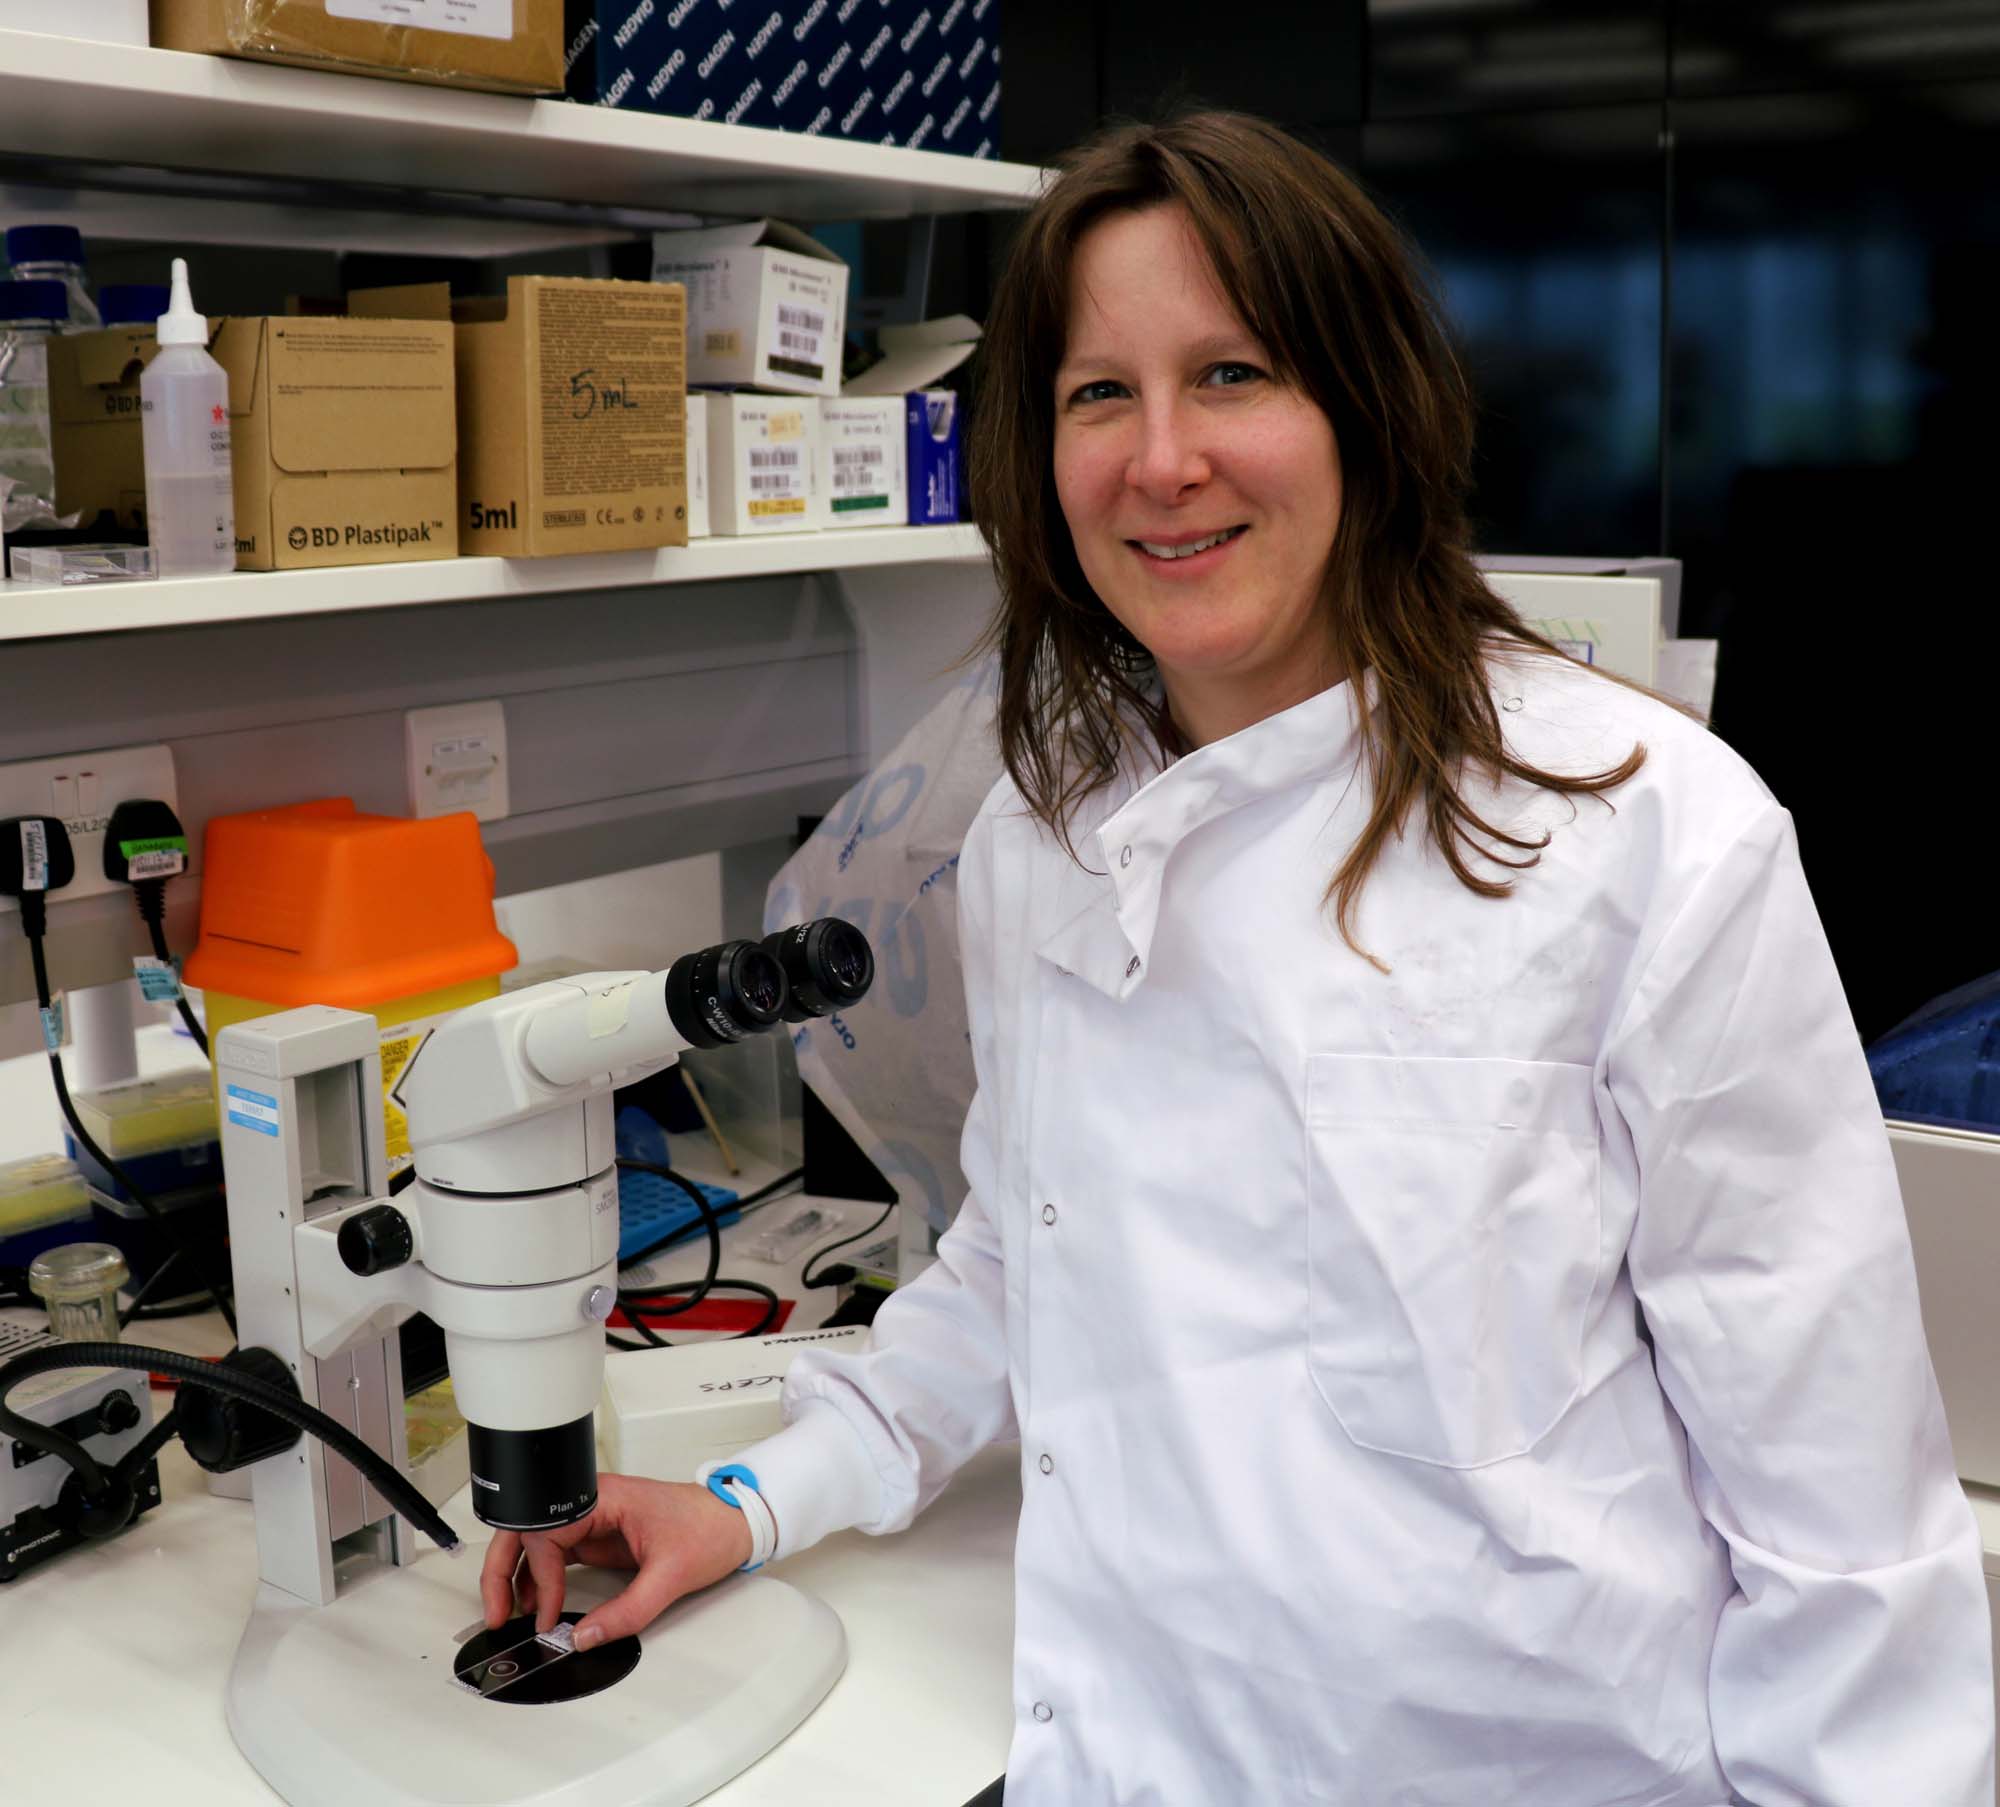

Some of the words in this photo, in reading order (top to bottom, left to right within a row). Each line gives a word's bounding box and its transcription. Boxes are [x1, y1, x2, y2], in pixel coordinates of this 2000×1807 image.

[614, 0, 654, 48] QIAGEN
[746, 12, 783, 58] QIAGEN
[647, 49, 685, 98] QIAGEN
[698, 30, 735, 78] QIAGEN
[818, 42, 851, 87] QIAGEN
[725, 79, 762, 124] QIAGEN
[772, 60, 808, 106] QIAGEN
[841, 88, 873, 133] QIAGEN
[311, 527, 339, 547] BD
[470, 501, 517, 529] 5ml
[549, 1501, 573, 1515] Plan
